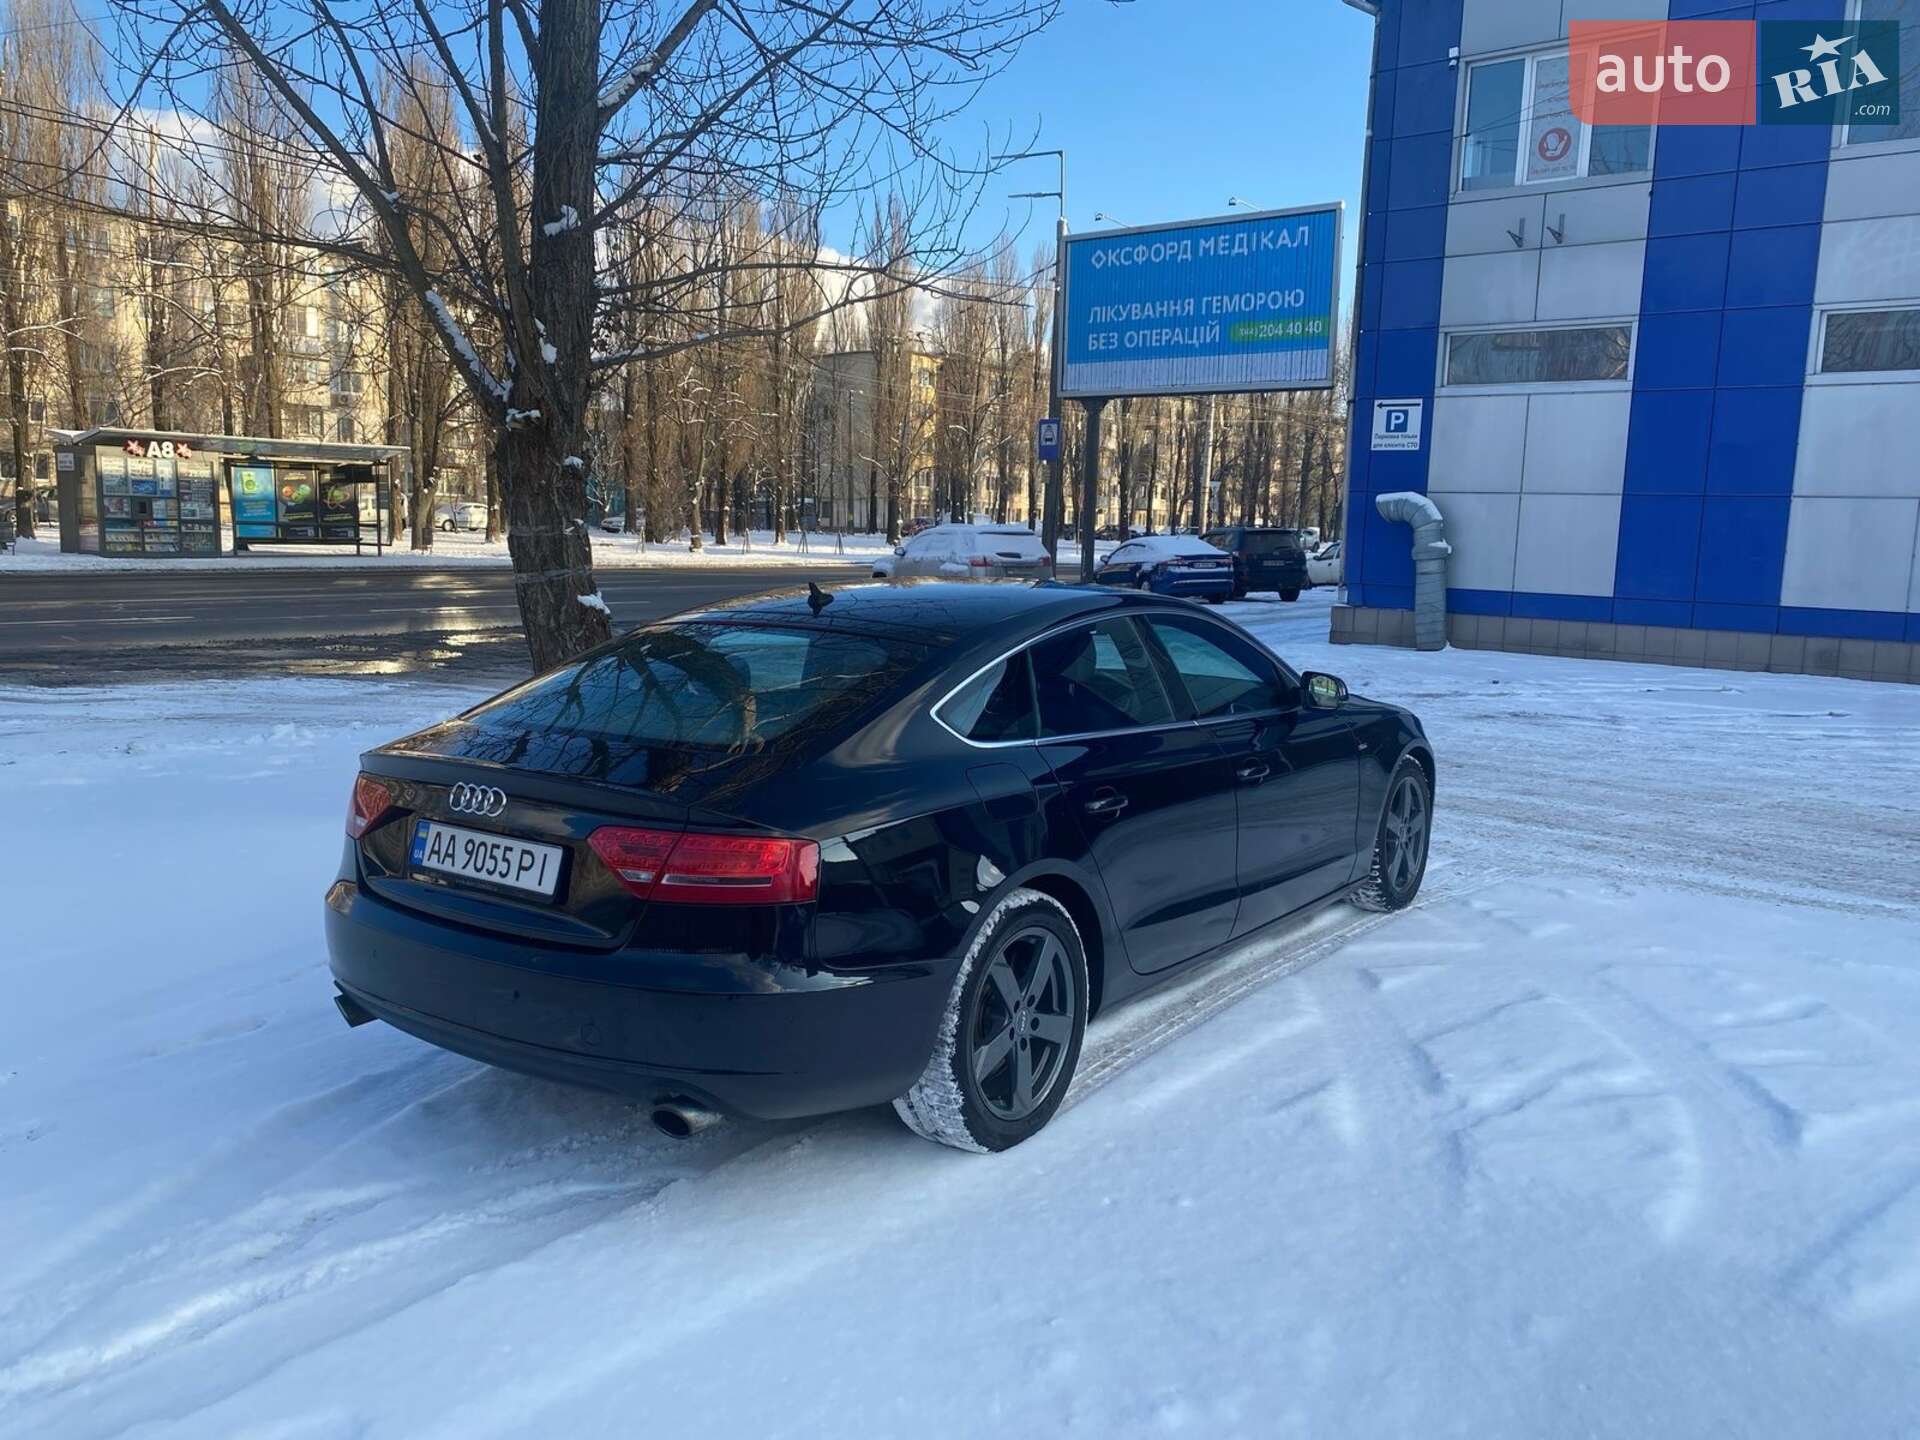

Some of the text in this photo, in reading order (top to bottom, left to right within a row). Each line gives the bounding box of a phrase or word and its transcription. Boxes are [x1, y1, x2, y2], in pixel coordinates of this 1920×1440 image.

[1091, 225, 1310, 269] ОКСФОРД МЕДІКАЛ
[1088, 288, 1305, 325] ЛІКУВАННЯ ГЕМОРОЮ
[1088, 321, 1220, 351] БЕЗ ОПЕРАЦІЙ
[1259, 322, 1283, 338] 204
[1286, 321, 1302, 336] 40
[1305, 319, 1322, 334] 40
[1390, 412, 1405, 431] P
[427, 831, 456, 867] AA
[461, 838, 513, 879] 9055
